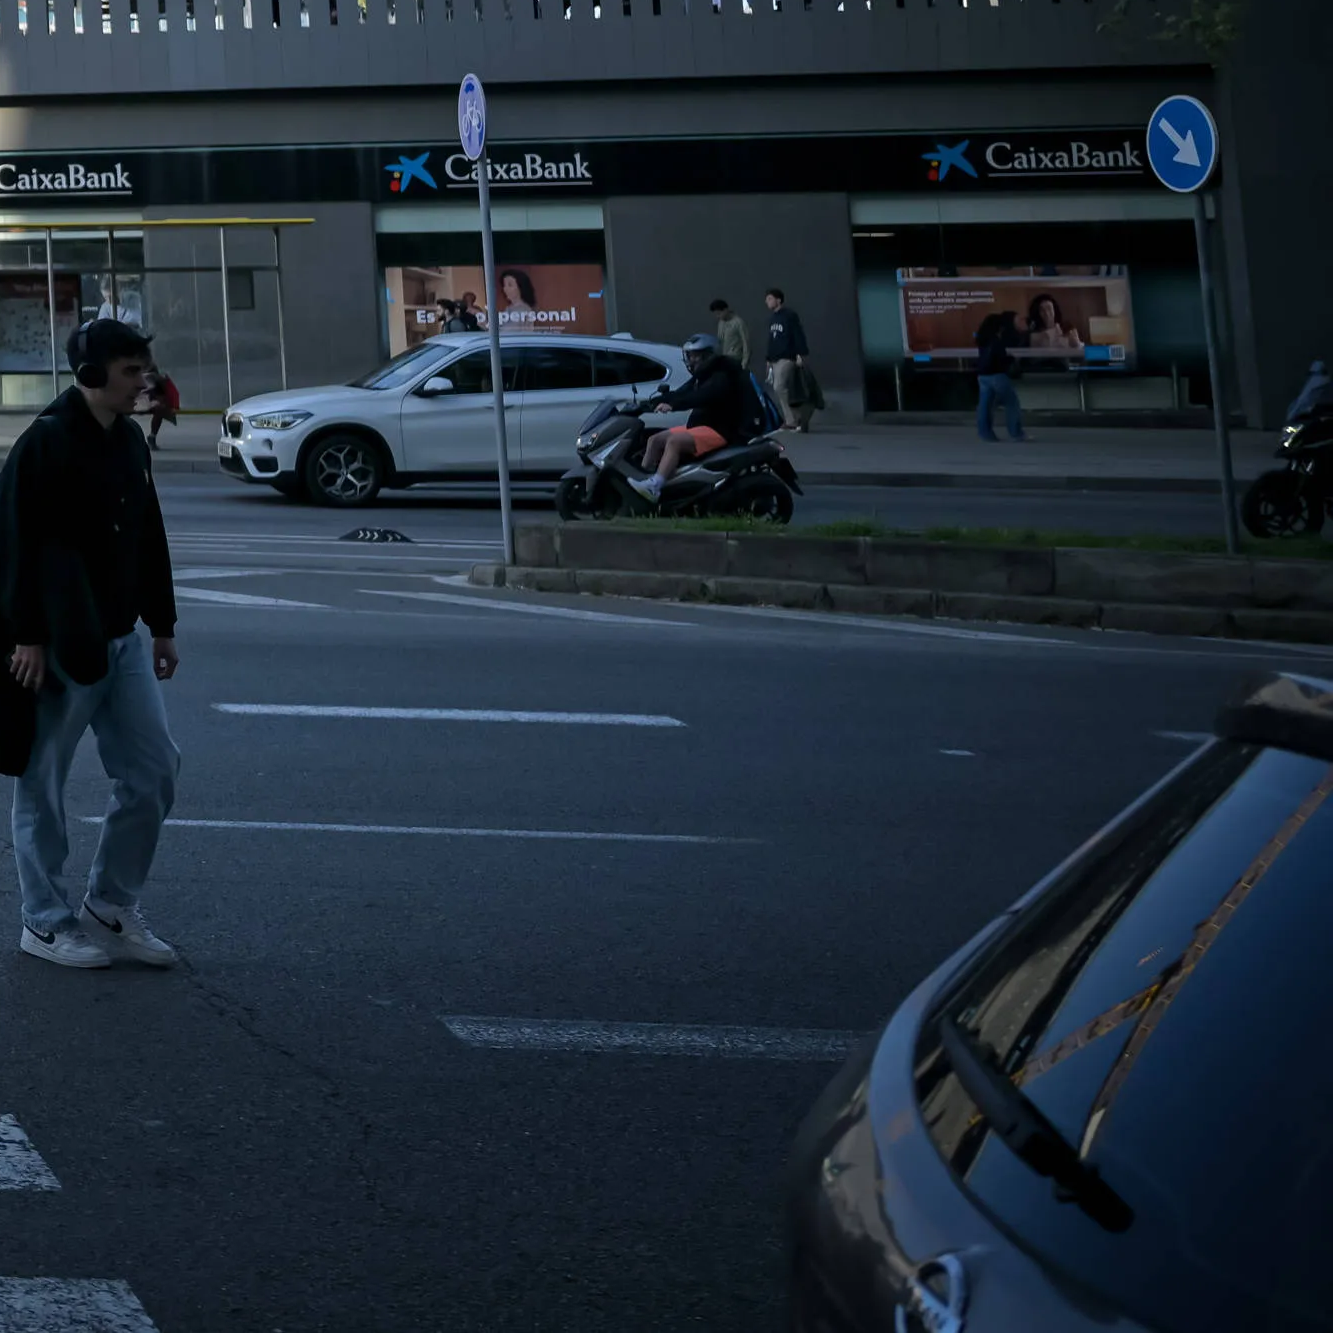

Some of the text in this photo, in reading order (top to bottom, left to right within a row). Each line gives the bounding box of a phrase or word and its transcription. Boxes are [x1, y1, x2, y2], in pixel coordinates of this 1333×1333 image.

[444, 154, 592, 183] CaixaBank
[985, 140, 1142, 170] CaixaBank
[499, 307, 576, 326] personal
